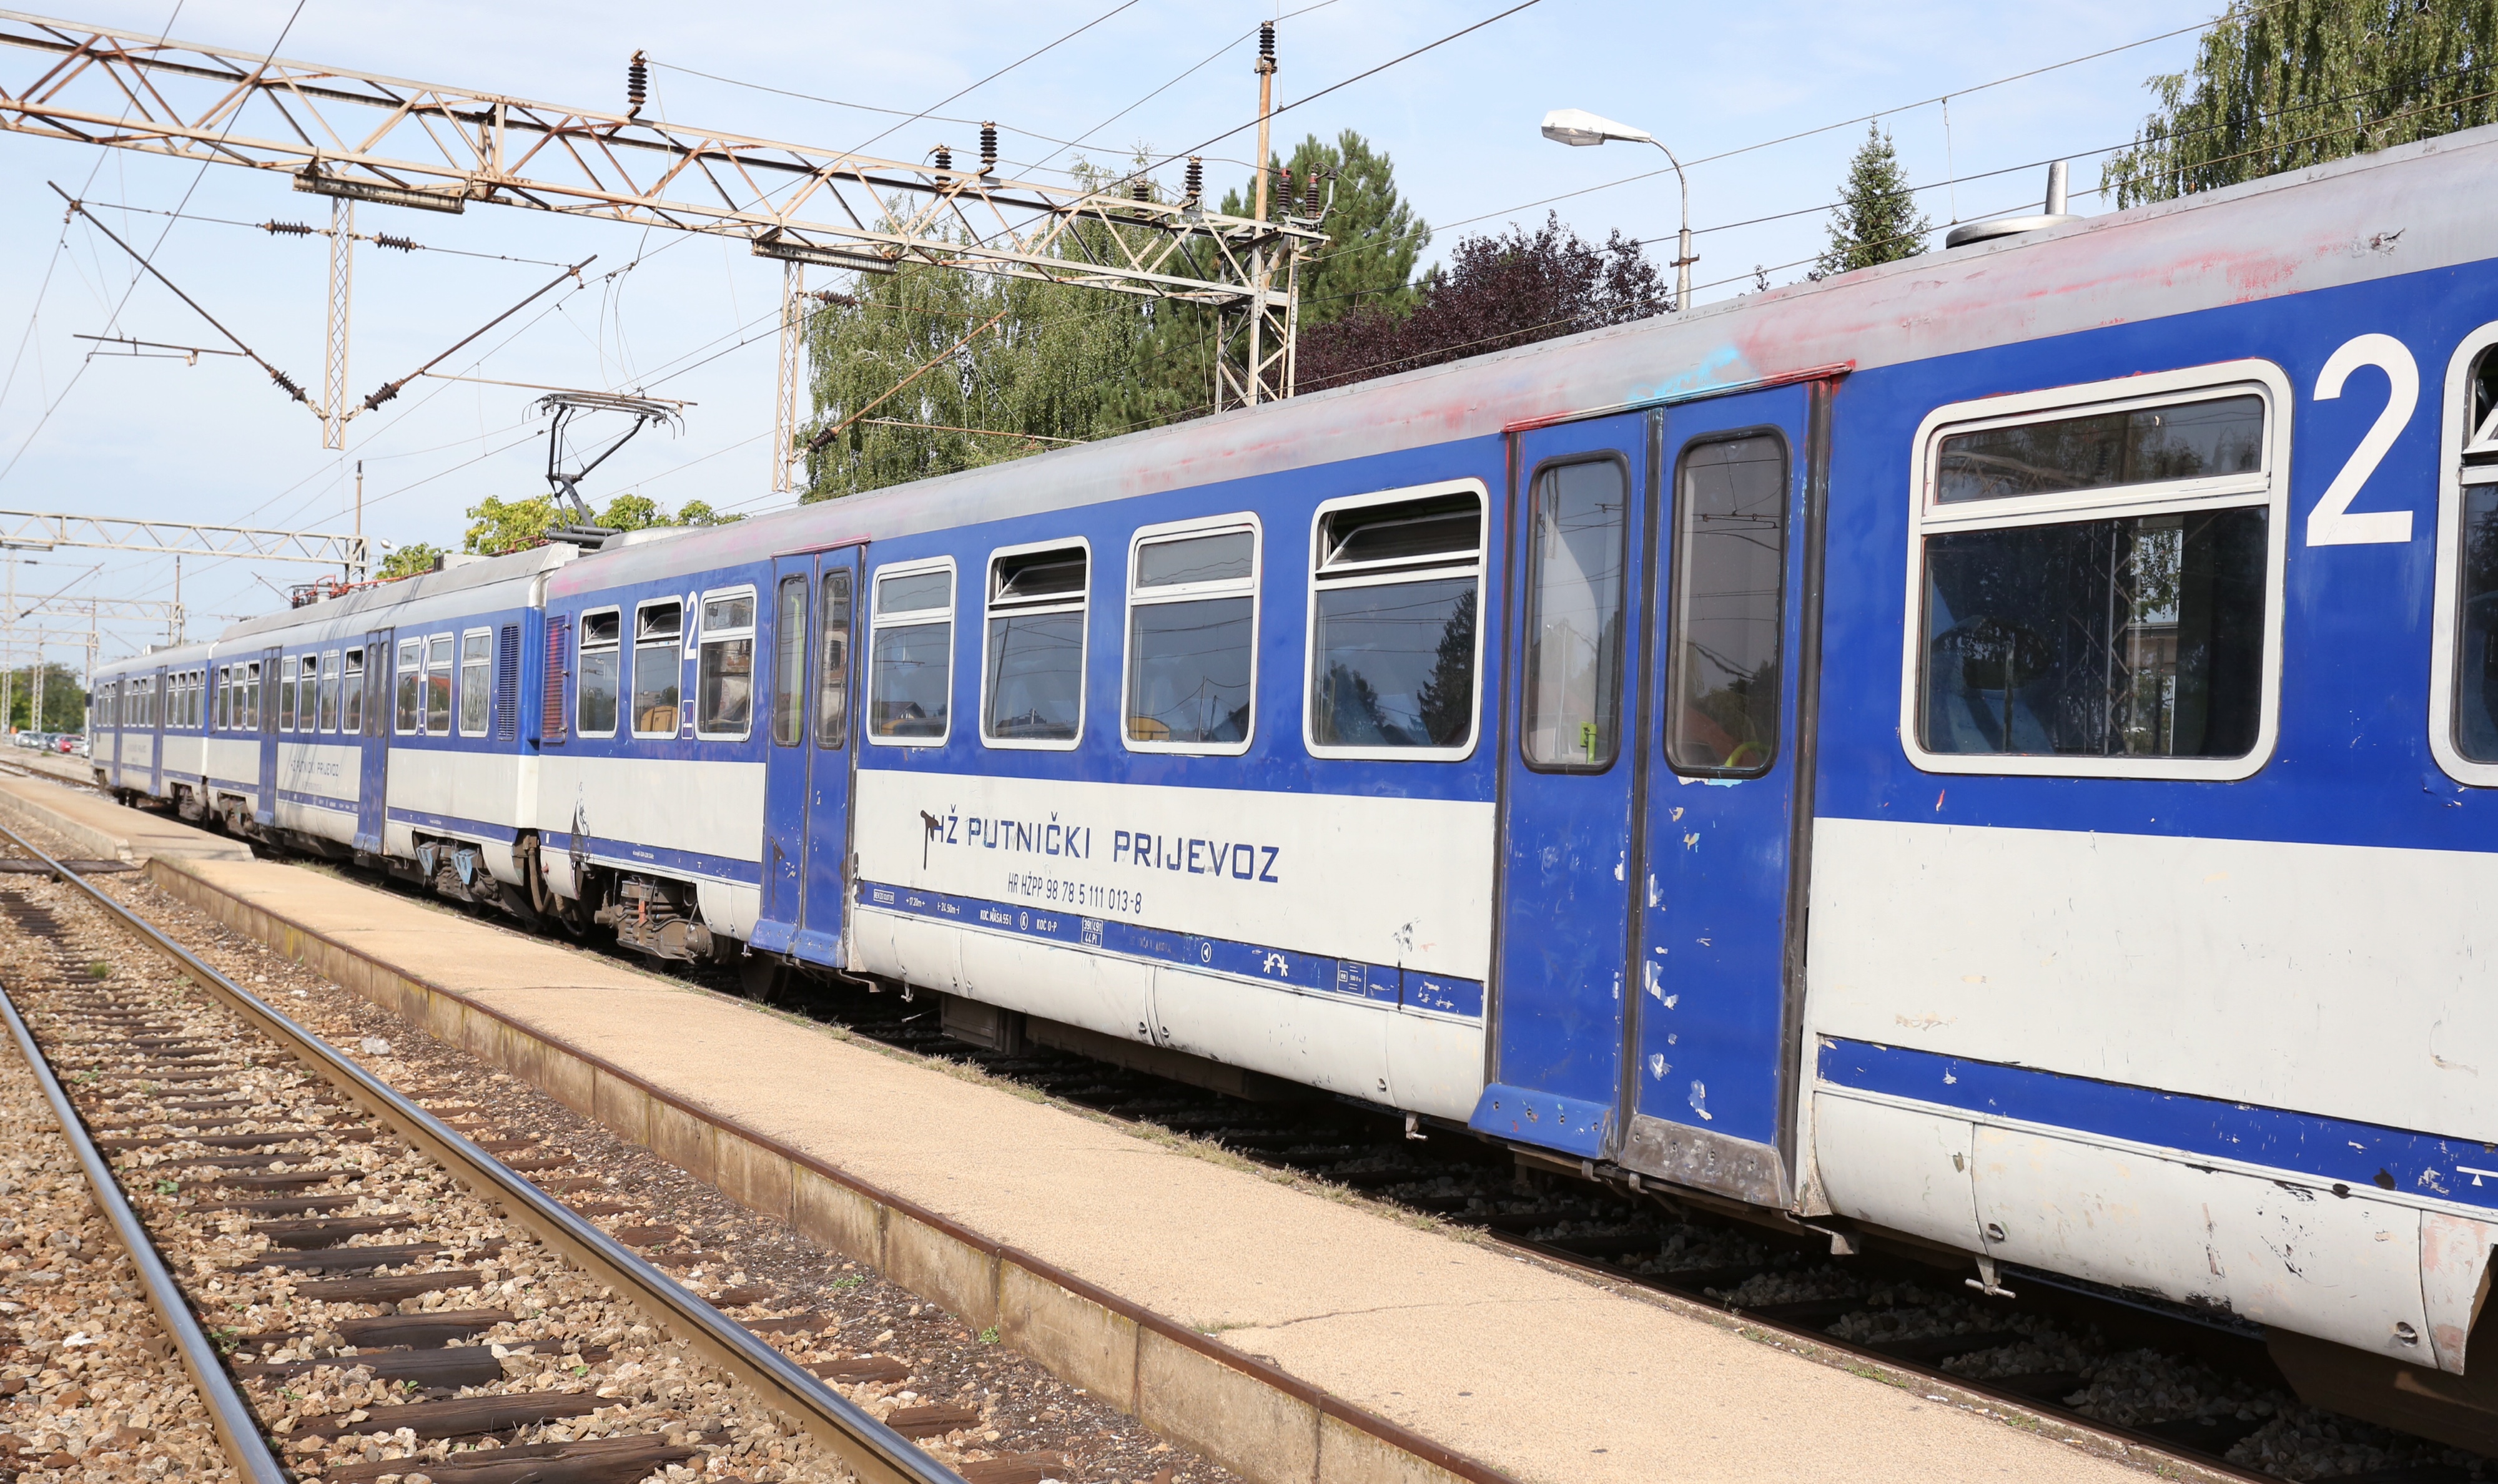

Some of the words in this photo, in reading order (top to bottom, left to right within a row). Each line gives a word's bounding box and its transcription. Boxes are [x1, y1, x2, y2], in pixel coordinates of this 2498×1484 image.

[2306, 333, 2419, 547] 2
[421, 634, 428, 682] 2
[684, 591, 698, 660] 2
[931, 803, 958, 844] HŽ
[968, 811, 1090, 859] PUTNIČKI
[1113, 830, 1279, 883] PRIJEVOZ
[1008, 872, 1019, 893] HR
[1021, 871, 1043, 897] HŽPP
[1046, 879, 1059, 900] 98
[1062, 881, 1074, 903] 78
[1079, 883, 1085, 905] 5
[1089, 885, 1103, 908] 111
[1108, 888, 1142, 914] 013-8
